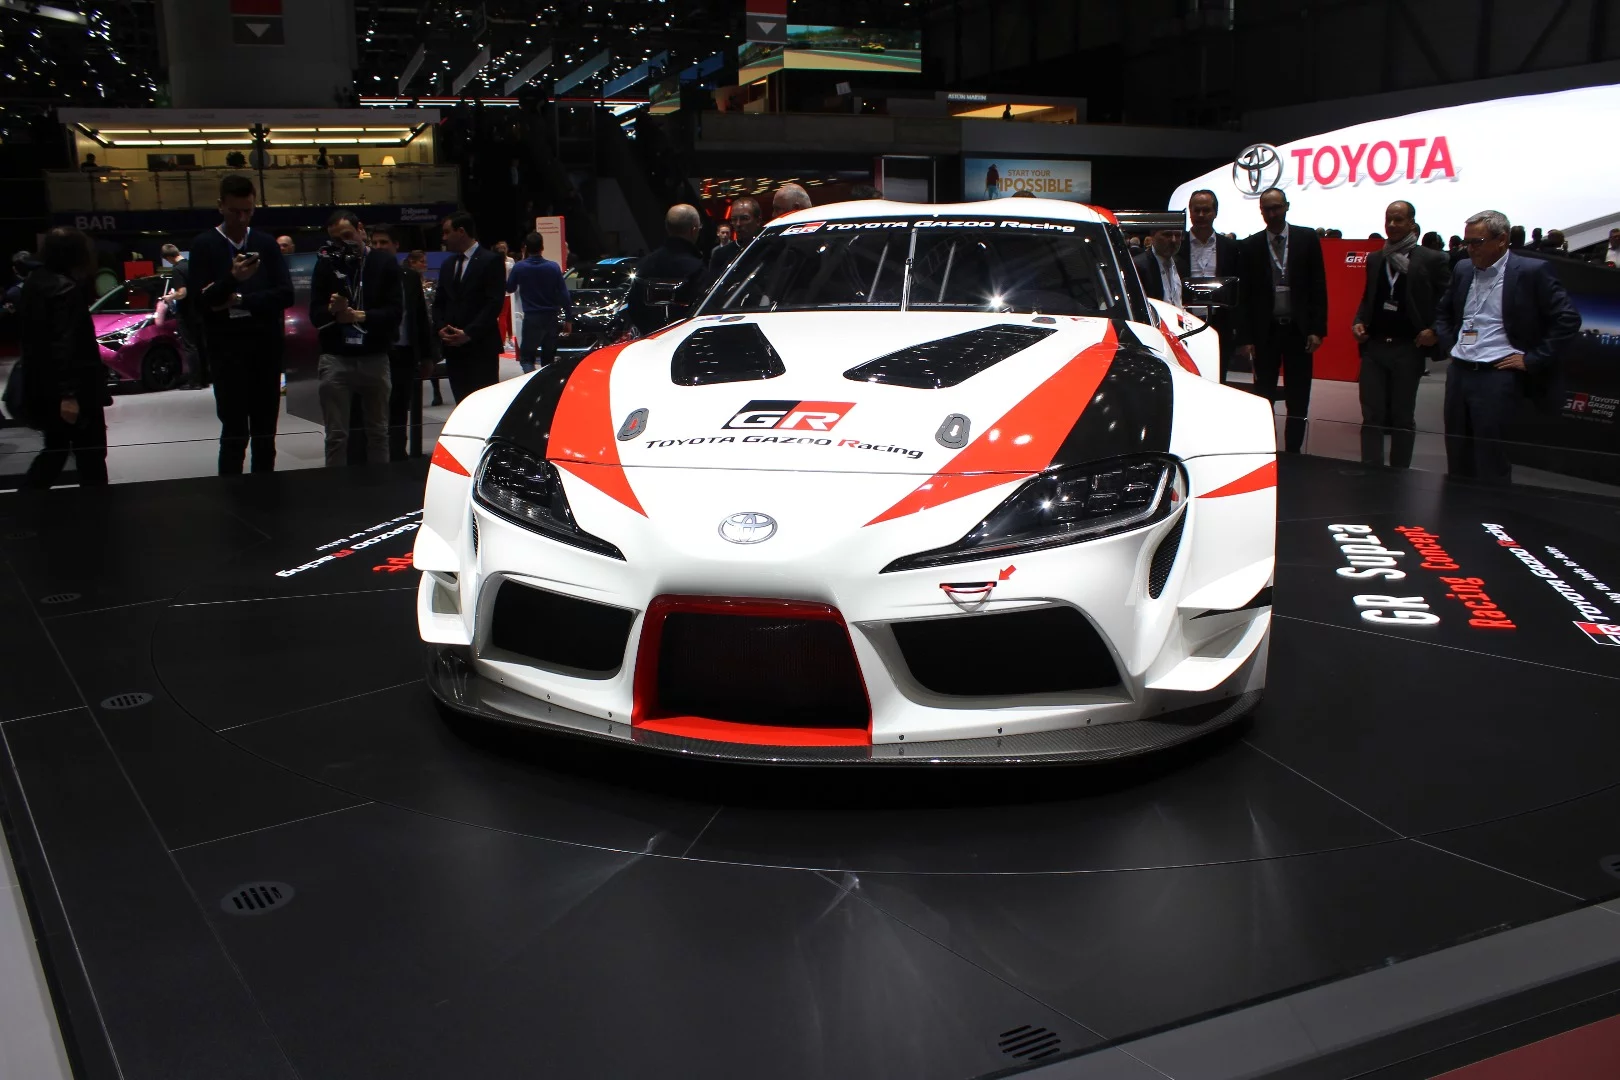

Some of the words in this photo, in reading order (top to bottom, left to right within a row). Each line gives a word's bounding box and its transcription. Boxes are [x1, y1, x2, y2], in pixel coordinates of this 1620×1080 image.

[1008, 169, 1029, 177] START
[1031, 169, 1051, 177] YOUR
[1291, 136, 1455, 186] TOYOTA
[75, 216, 116, 231] BAR
[827, 221, 909, 231] TOYOTA
[914, 220, 996, 228] GAZOO
[1000, 220, 1076, 233] Racing
[727, 410, 841, 430] GR
[646, 436, 735, 449] TOYOTA
[742, 435, 832, 446] GAZOO
[837, 438, 924, 459] Racing
[1394, 525, 1460, 570] Concept
[1481, 522, 1521, 548] Racing
[1327, 523, 1406, 580] Supra
[1353, 594, 1441, 625] GR
[1439, 576, 1517, 629] Racing
[1546, 579, 1611, 622] TOYOTA
